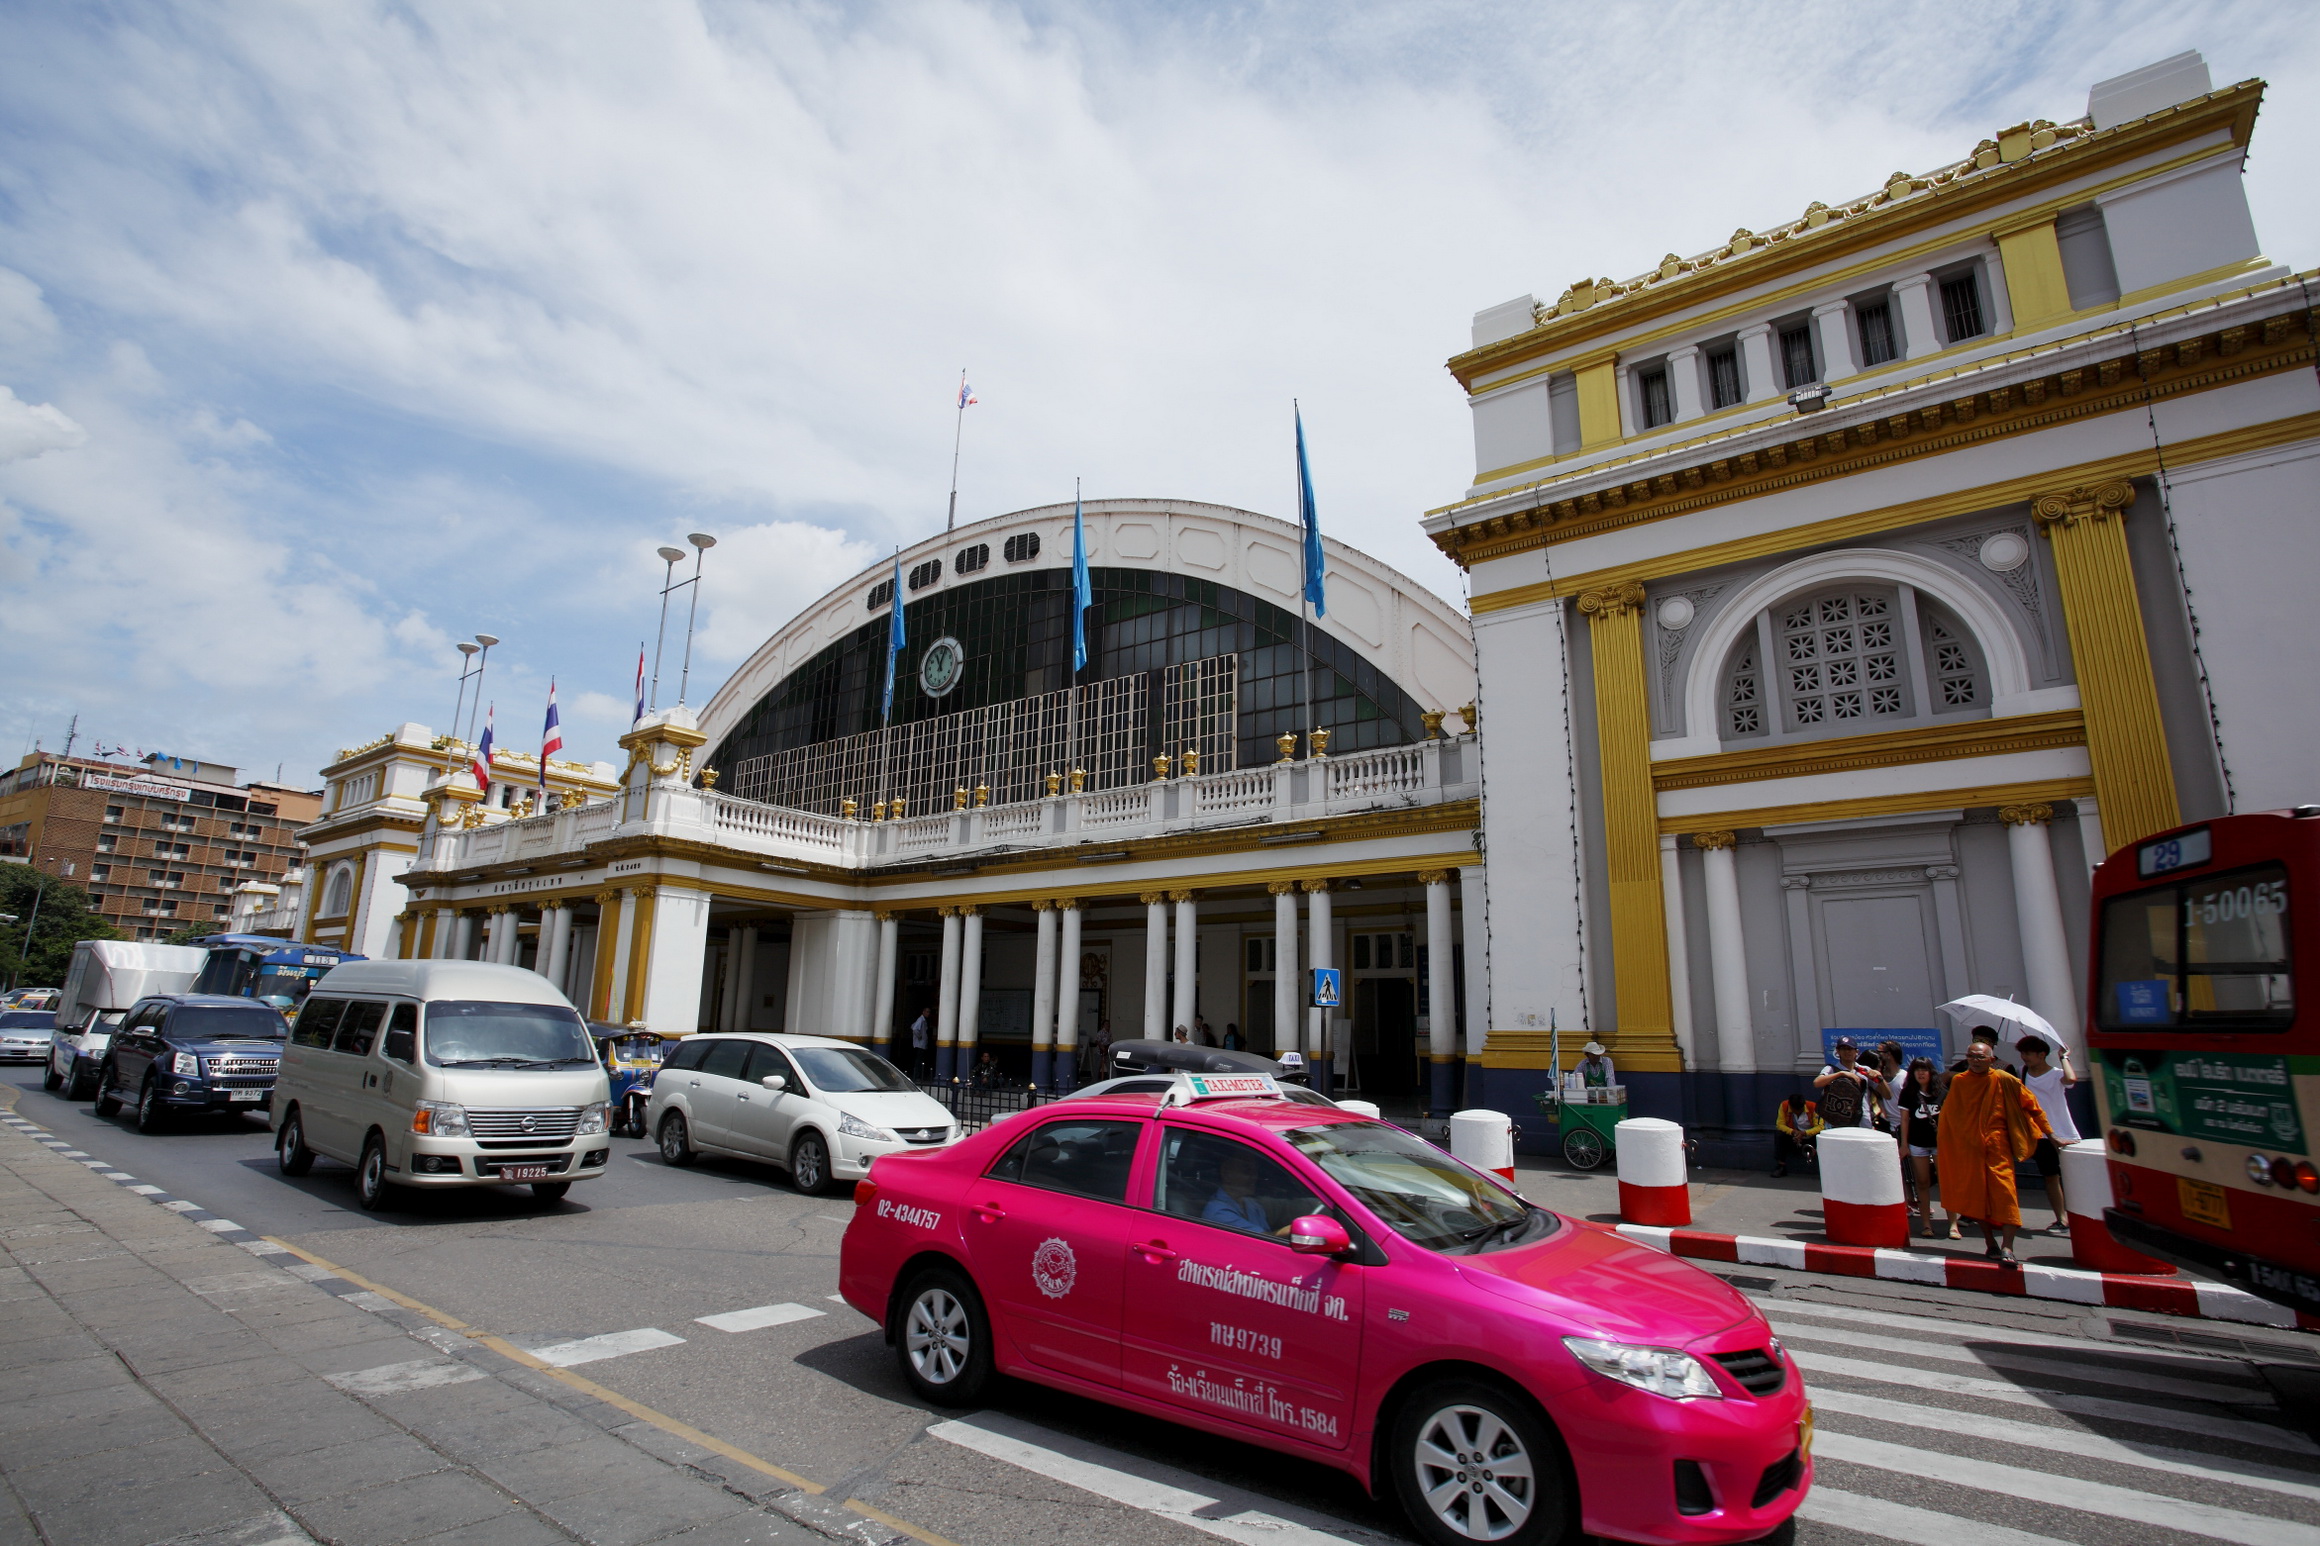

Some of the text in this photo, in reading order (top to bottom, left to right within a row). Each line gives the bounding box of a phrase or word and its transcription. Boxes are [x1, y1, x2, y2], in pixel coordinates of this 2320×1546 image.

[2153, 840, 2182, 870] 29
[2184, 879, 2288, 928] 1-50065
[1288, 1054, 1300, 1062] TAXI
[1203, 1078, 1266, 1092] TAXI-METER
[517, 1167, 547, 1178] 19225
[877, 1199, 941, 1230] 02-4344757
